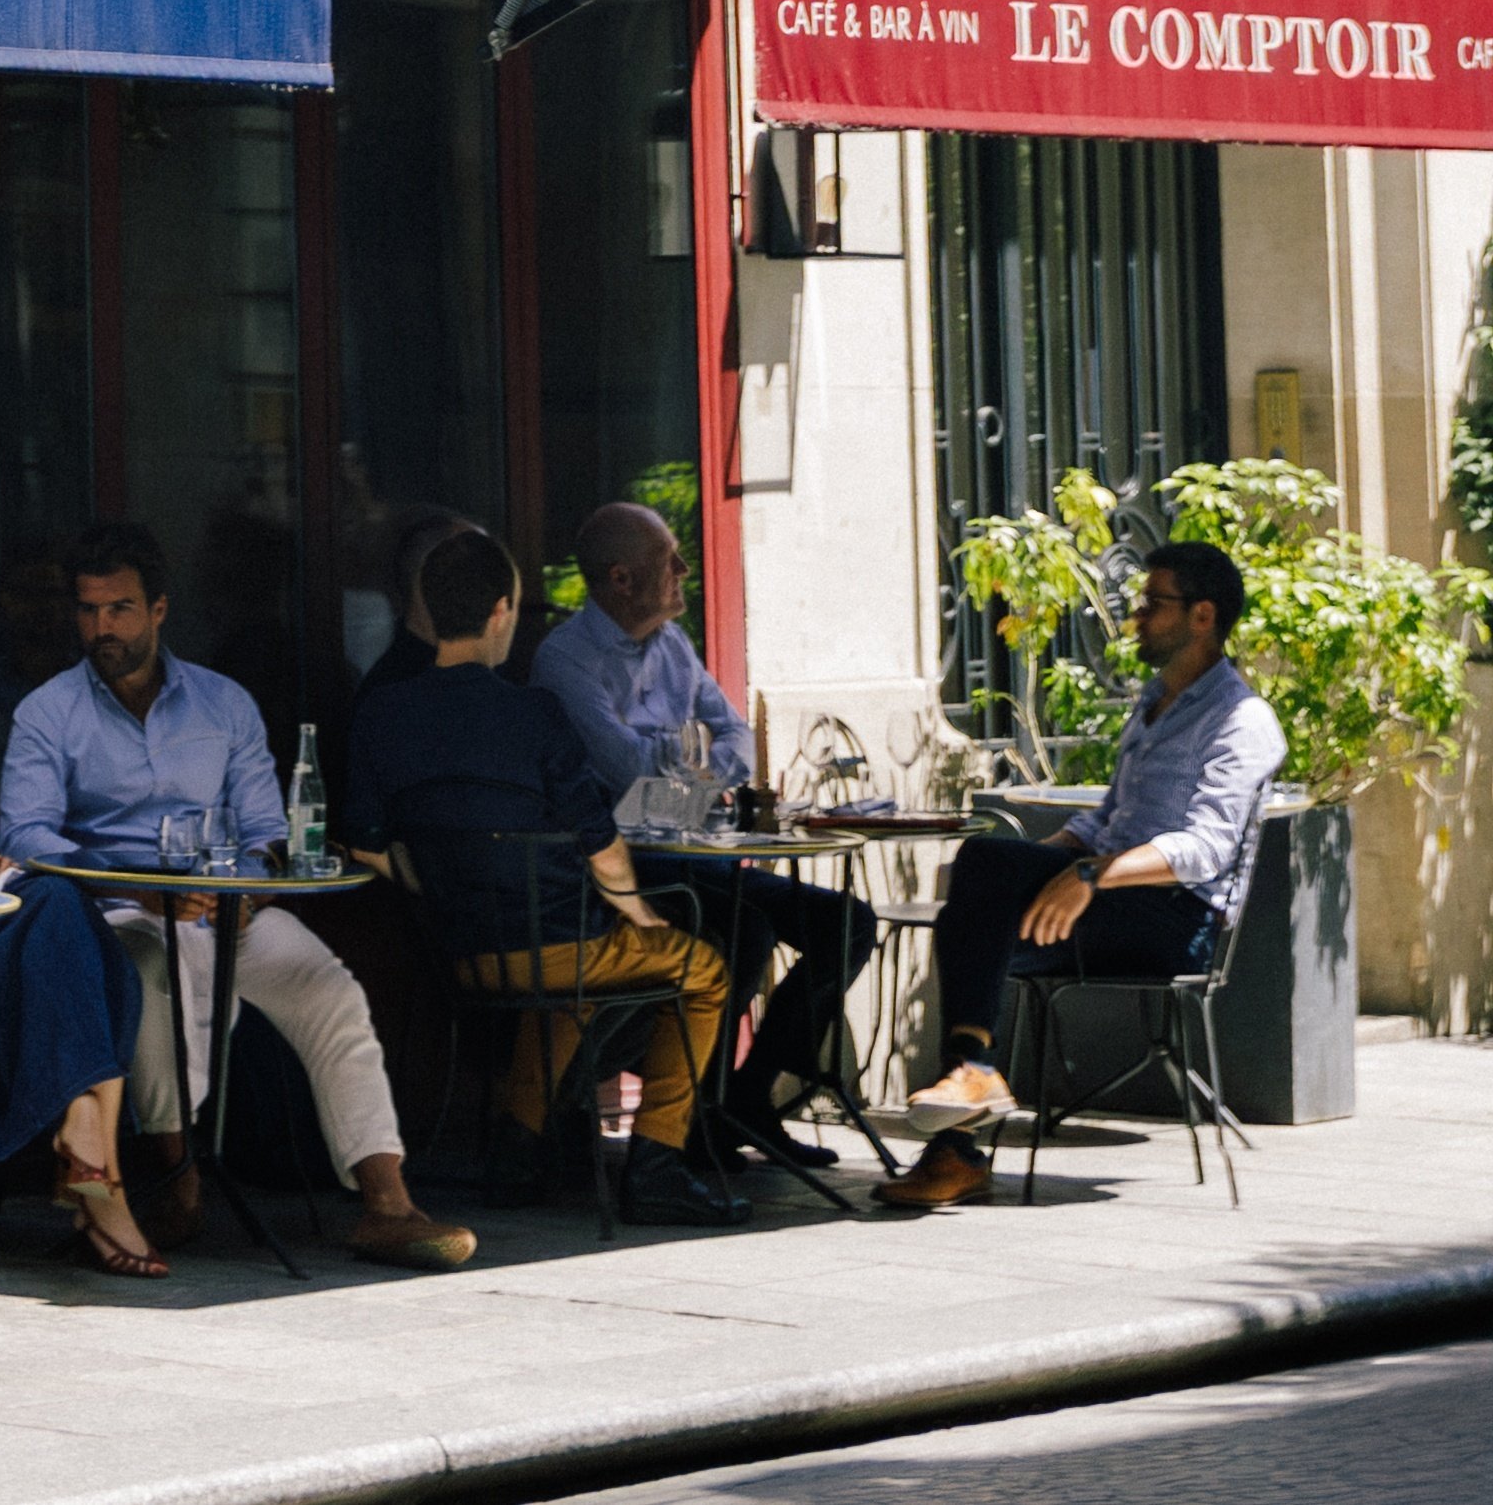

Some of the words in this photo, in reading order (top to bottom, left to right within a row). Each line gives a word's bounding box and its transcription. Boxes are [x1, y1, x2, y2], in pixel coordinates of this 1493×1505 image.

[843, 2, 862, 39] &
[869, 4, 913, 41] BAR
[917, 0, 936, 42] À
[938, 8, 980, 44] VIN
[1008, 0, 1091, 66] LE
[1108, 4, 1437, 82] COMPTOIR
